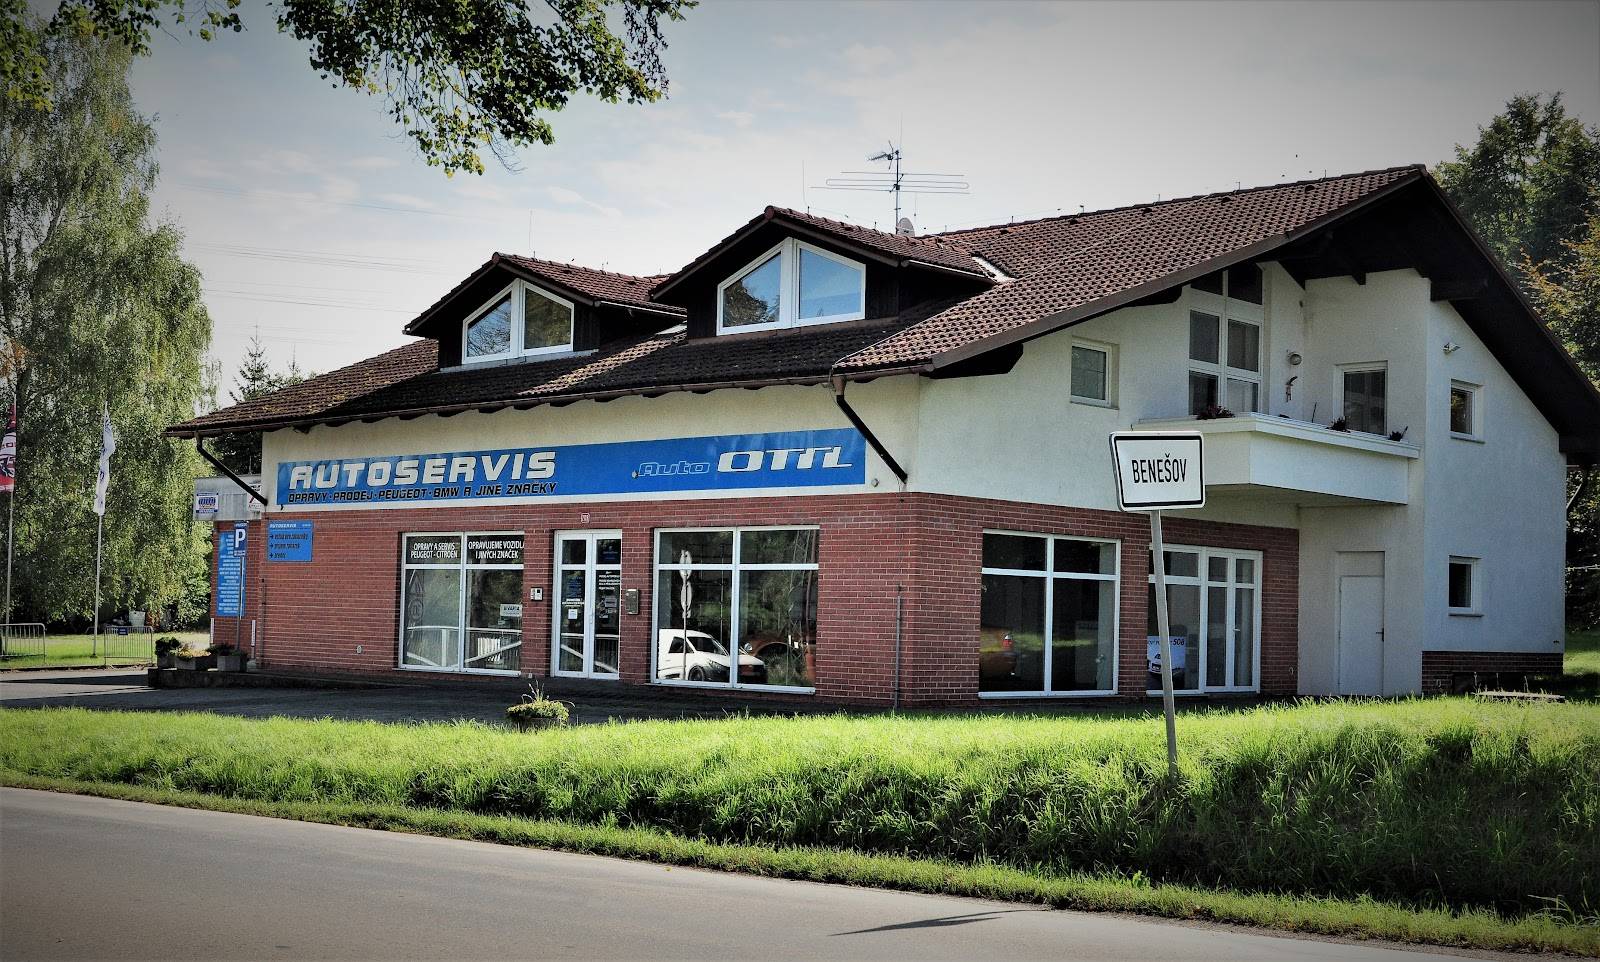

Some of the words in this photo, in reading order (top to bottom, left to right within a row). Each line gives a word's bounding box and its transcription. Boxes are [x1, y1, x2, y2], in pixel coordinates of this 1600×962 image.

[288, 451, 556, 490] AUTOSERVIS
[638, 460, 710, 476] Auto
[1131, 452, 1187, 484] BENEŠOV
[433, 486, 460, 498] BMW
[463, 486, 472, 497] A
[234, 528, 246, 548] P
[413, 543, 433, 551] OPRAVY
[434, 542, 439, 550] A
[439, 542, 456, 550] SERVIS
[468, 541, 502, 550] OPRAVUJEME
[410, 550, 433, 559] PEUGEOT
[497, 549, 519, 559] ZNAČEK
